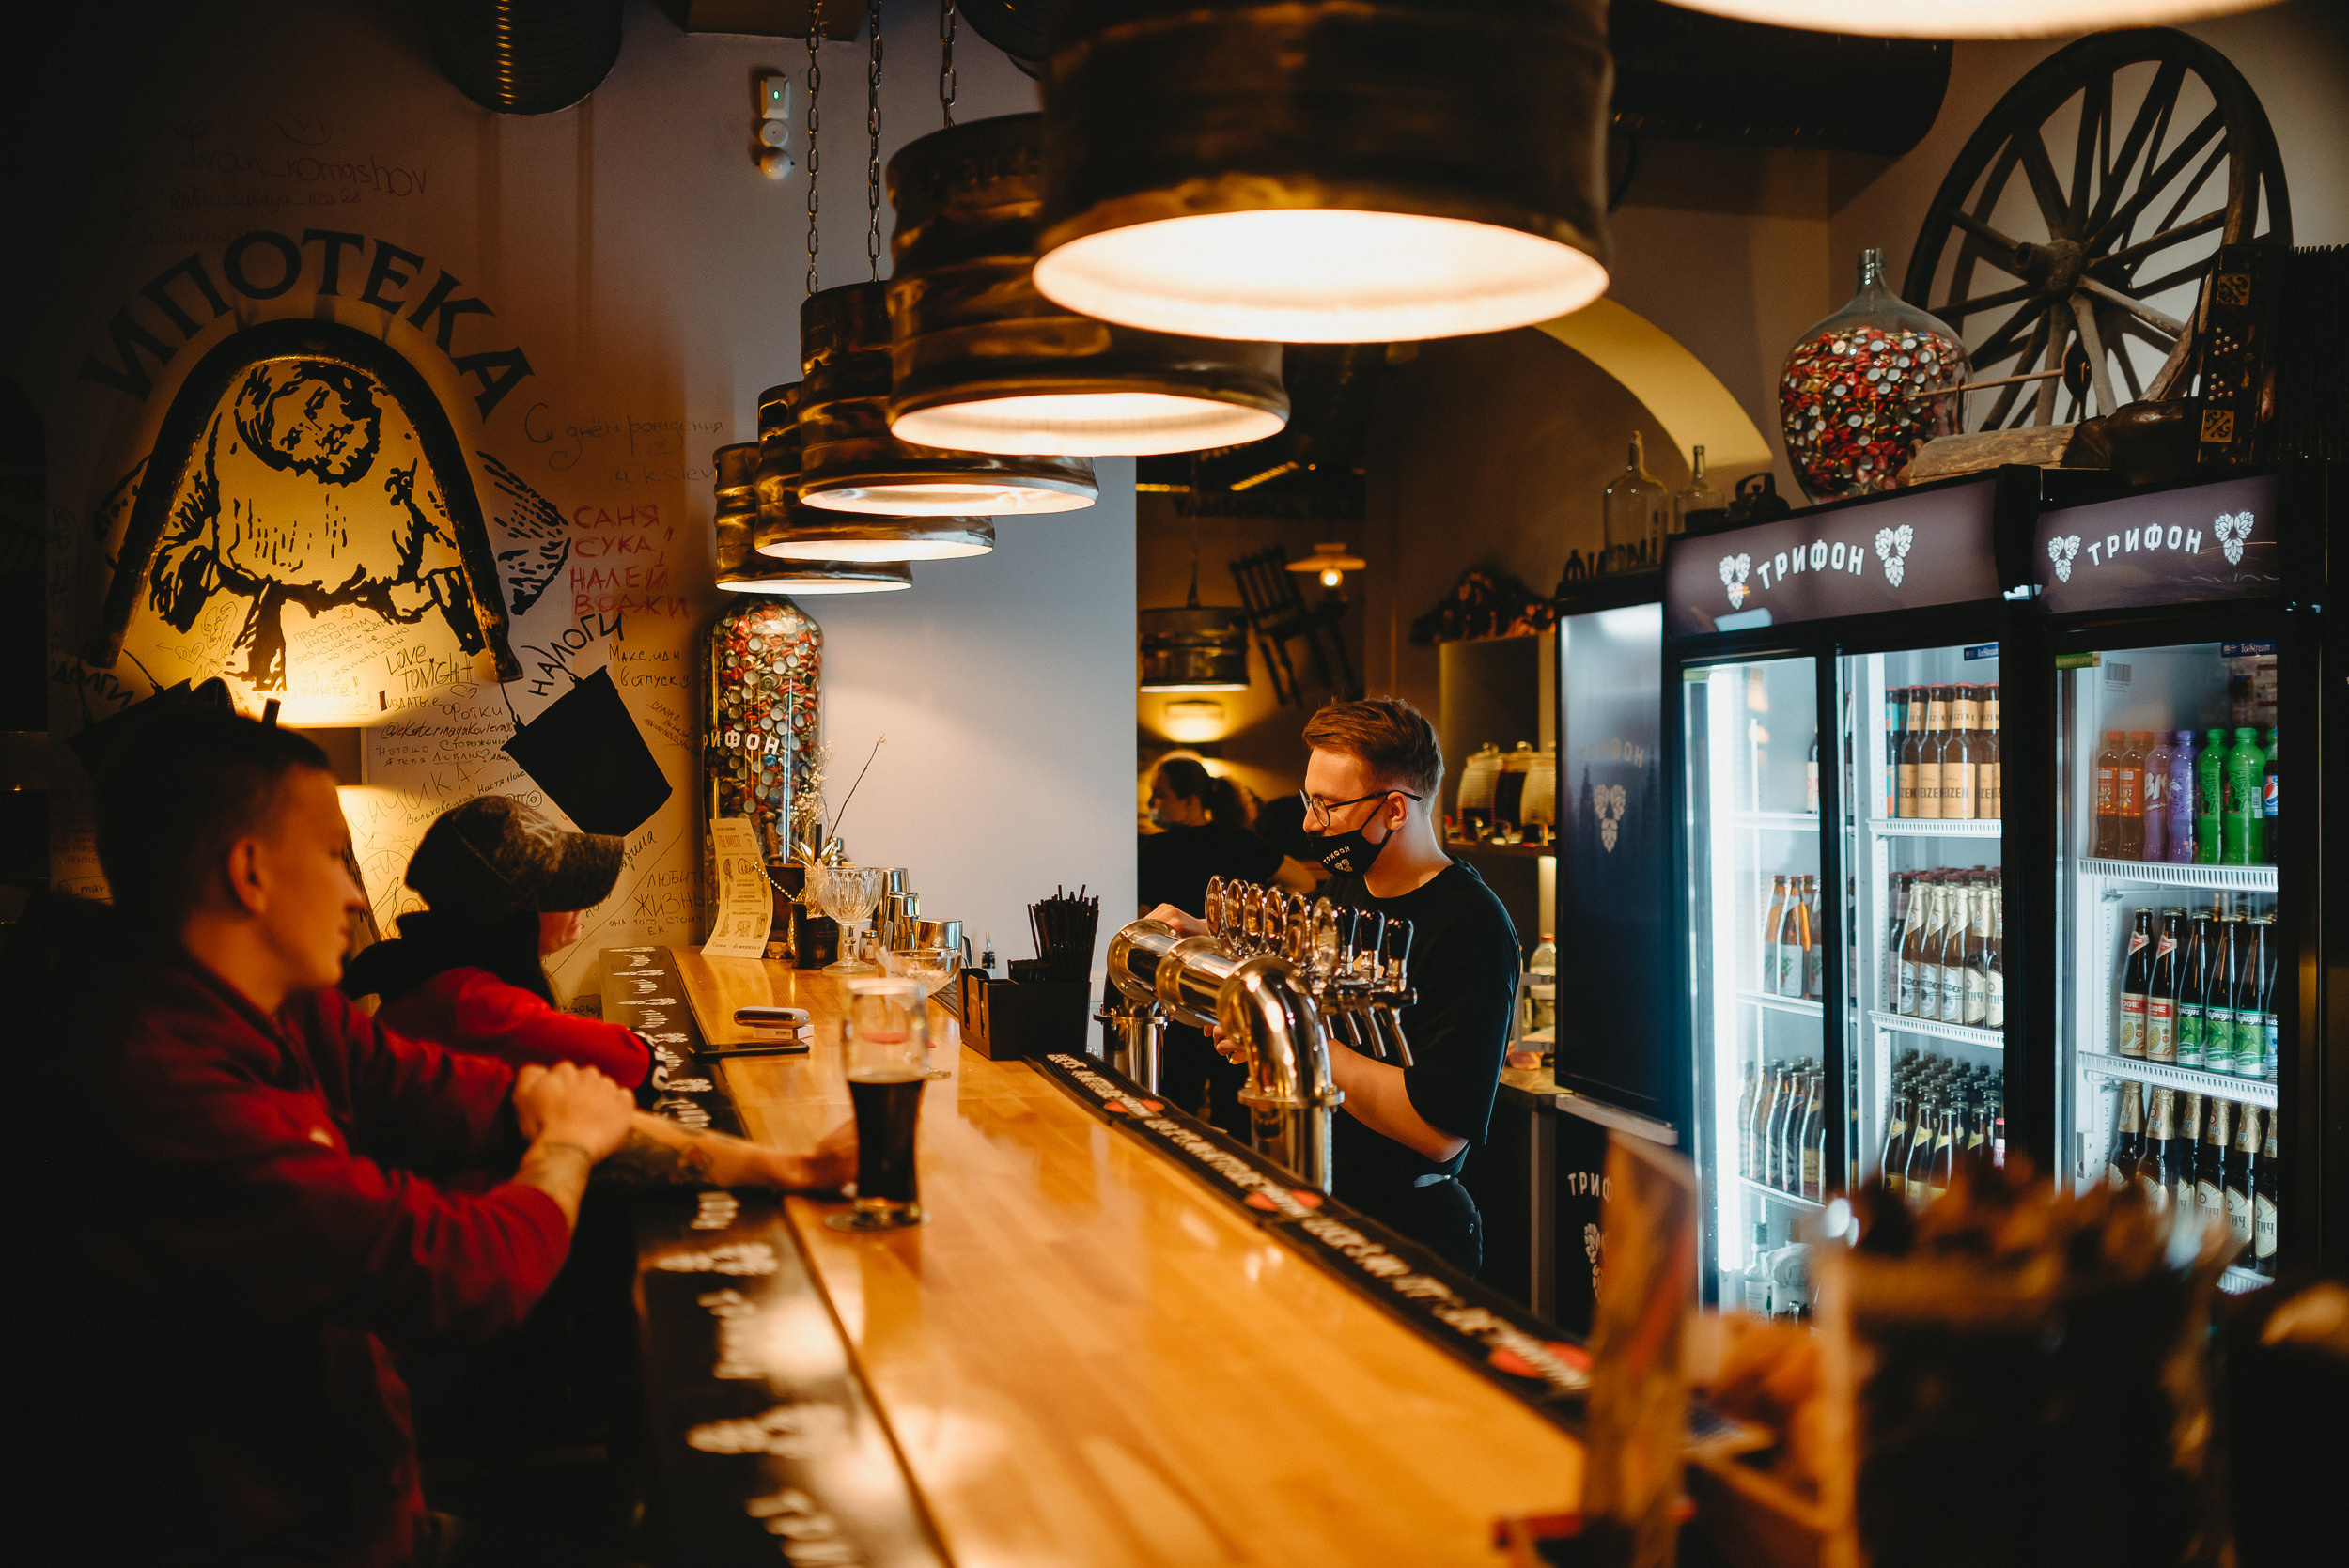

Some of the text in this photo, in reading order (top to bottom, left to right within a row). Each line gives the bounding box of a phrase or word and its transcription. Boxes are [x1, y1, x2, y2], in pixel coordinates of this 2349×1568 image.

[78, 228, 536, 424] ИПОТЕКА
[1756, 539, 1865, 590] ТРИФОН
[2087, 523, 2202, 566] ТРИФОН
[570, 561, 670, 594] НАЛЕЙ
[527, 613, 625, 697] НАЛОГИ
[49, 661, 133, 709] ДОЛГИ
[703, 729, 780, 755] РИФОН
[633, 892, 706, 917] ЖИЗНЬ
[1567, 1172, 1612, 1203] ТРИФ
